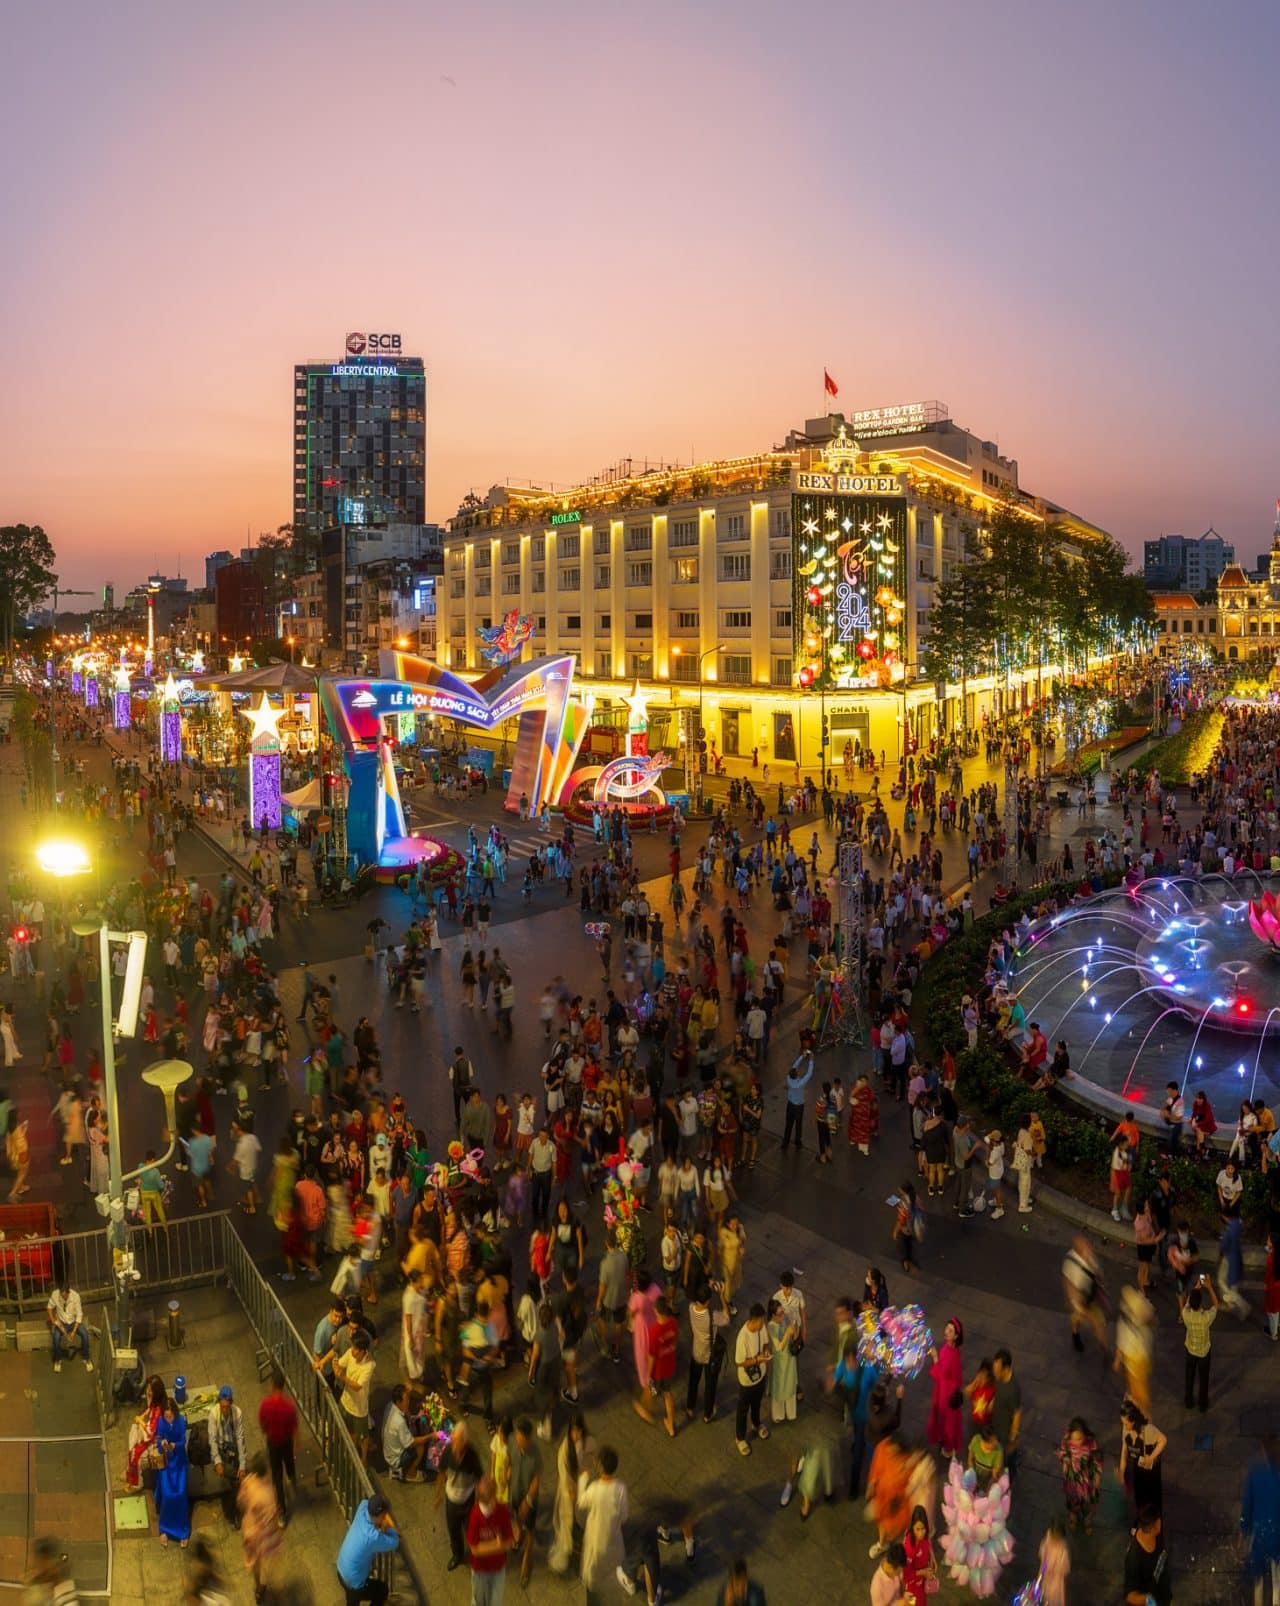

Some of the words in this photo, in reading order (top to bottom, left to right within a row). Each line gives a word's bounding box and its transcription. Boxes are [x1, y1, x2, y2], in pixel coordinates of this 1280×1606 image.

[368, 334, 402, 348] SCB
[332, 366, 363, 376] LIBERTY
[363, 366, 399, 376] CENTRAL
[854, 409, 880, 422] REX
[883, 403, 925, 418] HOTEL
[799, 473, 832, 490] REX
[839, 476, 901, 492] HOTEL
[551, 511, 581, 525] ROLEX
[830, 705, 870, 714] CHANEL
